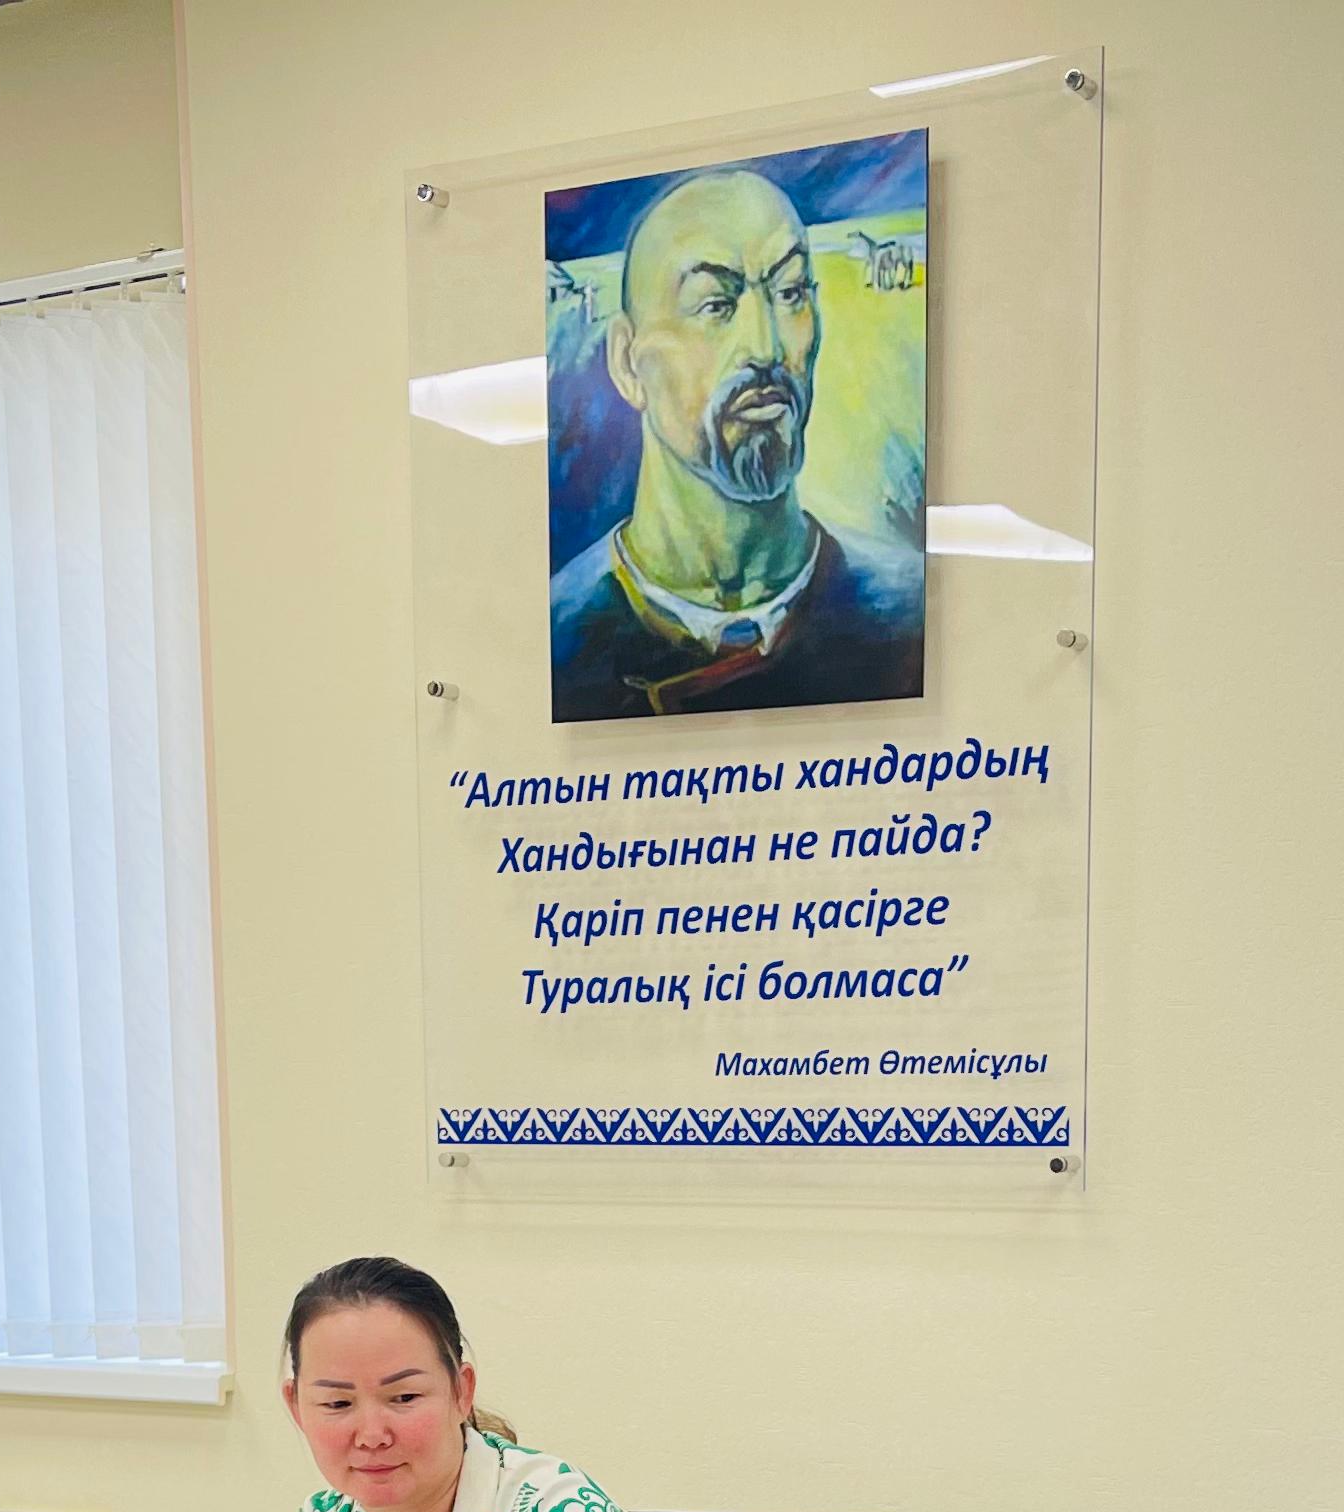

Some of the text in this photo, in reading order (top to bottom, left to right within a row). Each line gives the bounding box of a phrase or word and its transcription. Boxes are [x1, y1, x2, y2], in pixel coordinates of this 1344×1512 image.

[622, 763, 784, 804] тақты
[794, 738, 1049, 791] хандардың
[497, 809, 992, 873] Хандығынан не пайда?
[534, 888, 950, 946] Қаріп пенен қасірге
[522, 969, 690, 1013] Туралық
[704, 963, 748, 1002] ісі
[717, 1050, 1047, 1080] Махамбет Өтемісұлы
